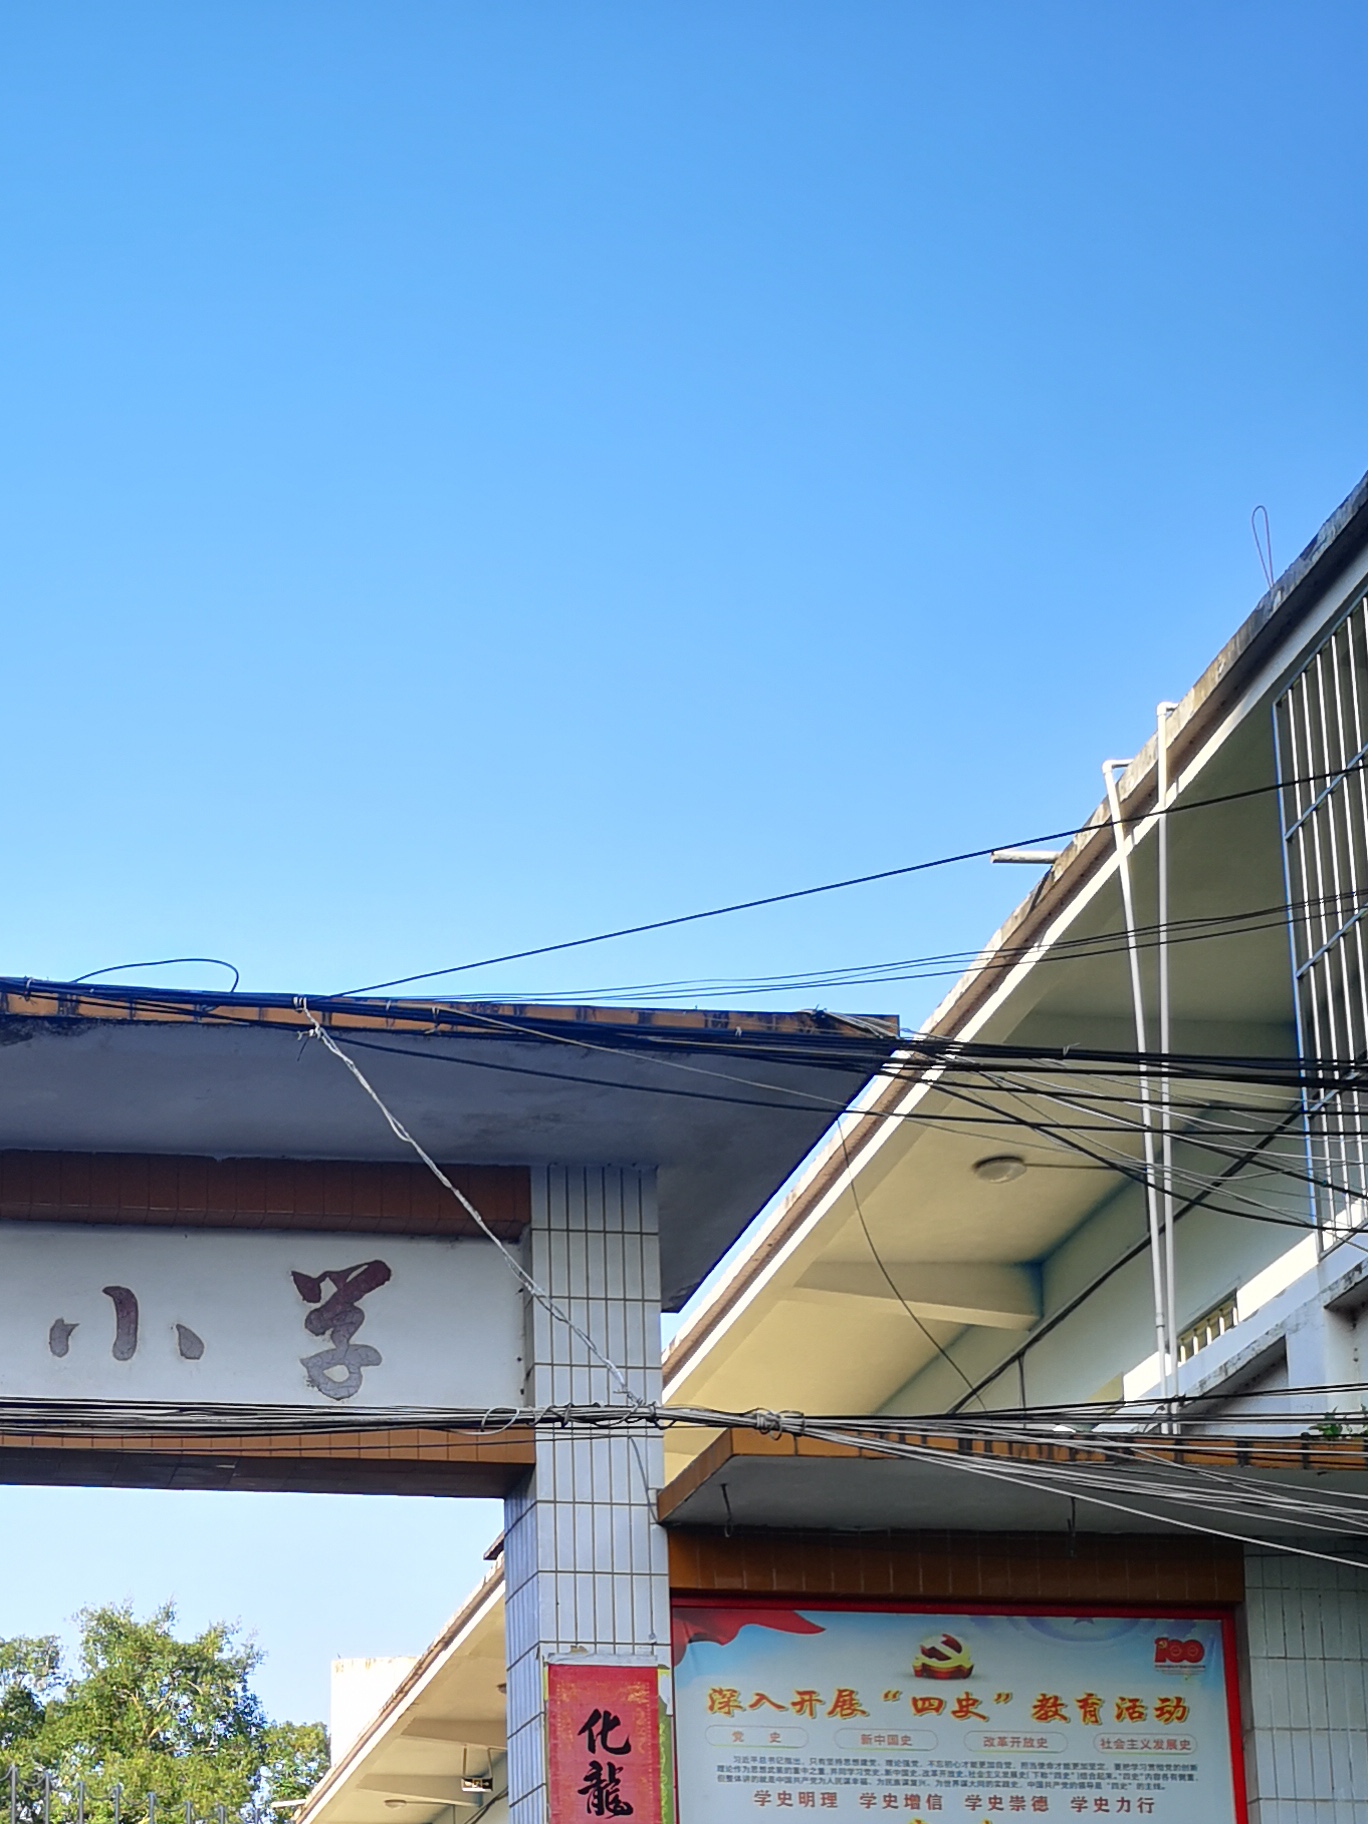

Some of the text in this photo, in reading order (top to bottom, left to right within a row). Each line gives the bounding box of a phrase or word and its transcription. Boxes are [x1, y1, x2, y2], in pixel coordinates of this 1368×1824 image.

[707, 1687, 1190, 1726] 深入开展“四史”教育活动
[860, 1733, 913, 1746] 新中国史
[983, 1736, 1049, 1748] 改革开放史
[1100, 1738, 1192, 1751] 社会主义发展史
[753, 1789, 1155, 1814] 学史明理 学史增信 学史崇德 学史力行
